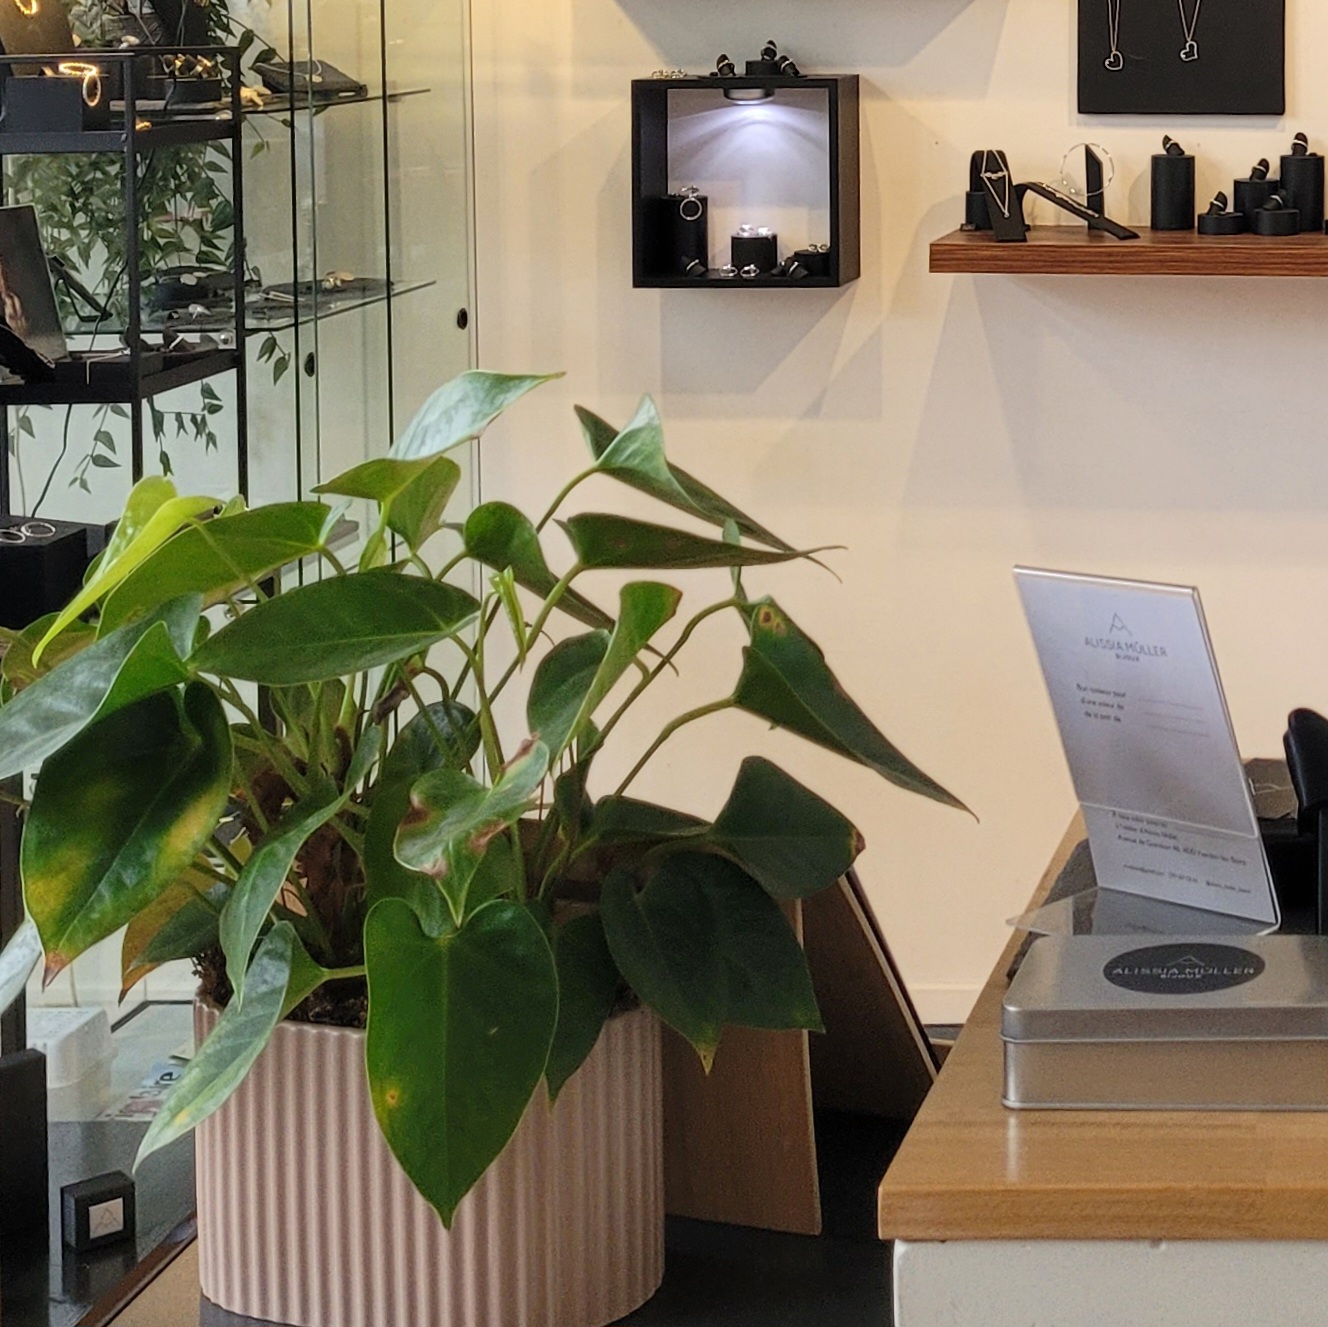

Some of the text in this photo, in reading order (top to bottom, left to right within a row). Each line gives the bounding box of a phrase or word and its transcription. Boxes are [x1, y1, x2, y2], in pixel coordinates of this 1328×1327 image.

[1084, 636, 1168, 658] ALISSIA MÜLLER
[1112, 966, 1255, 976] ALISSIA MÜLLER
